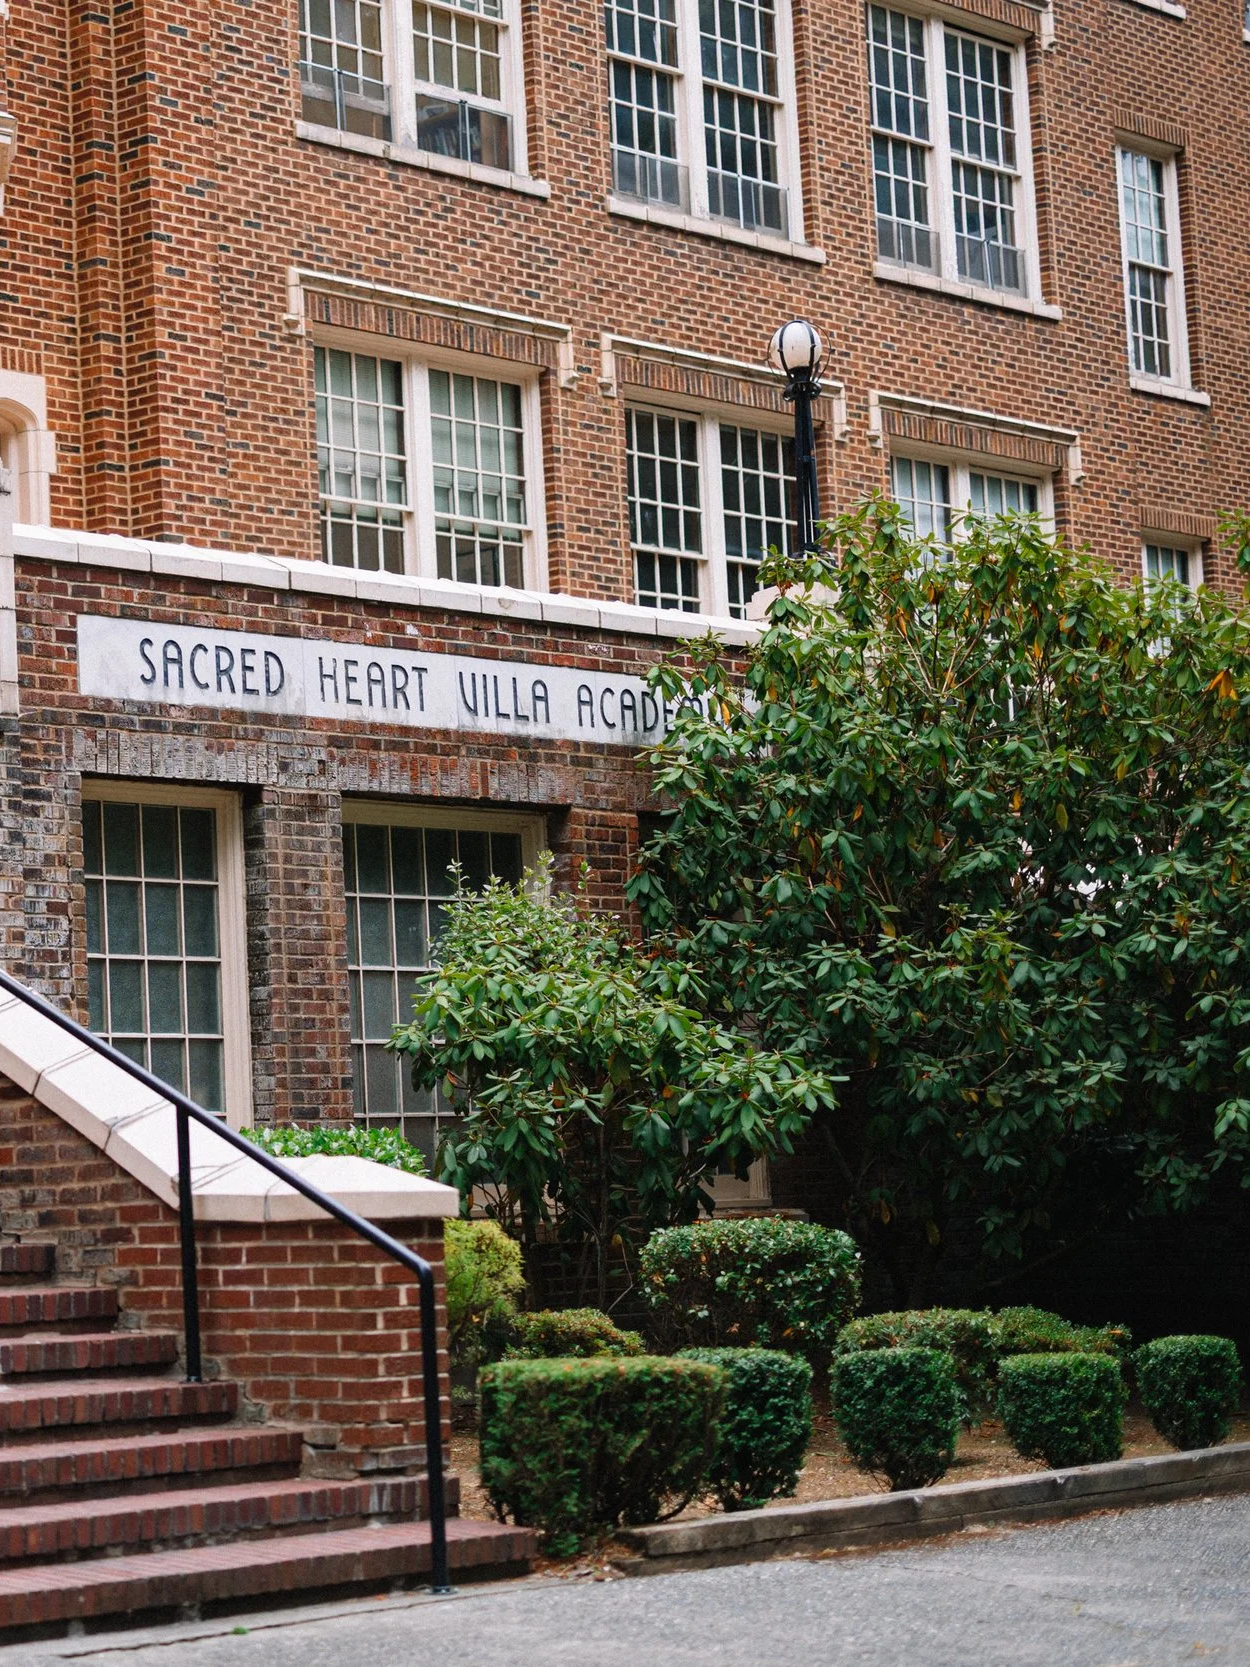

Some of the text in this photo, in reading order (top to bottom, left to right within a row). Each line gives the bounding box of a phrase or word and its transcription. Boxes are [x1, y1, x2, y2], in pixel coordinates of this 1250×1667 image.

[140, 637, 725, 734] SACRED HEART VILLA ACADEM
